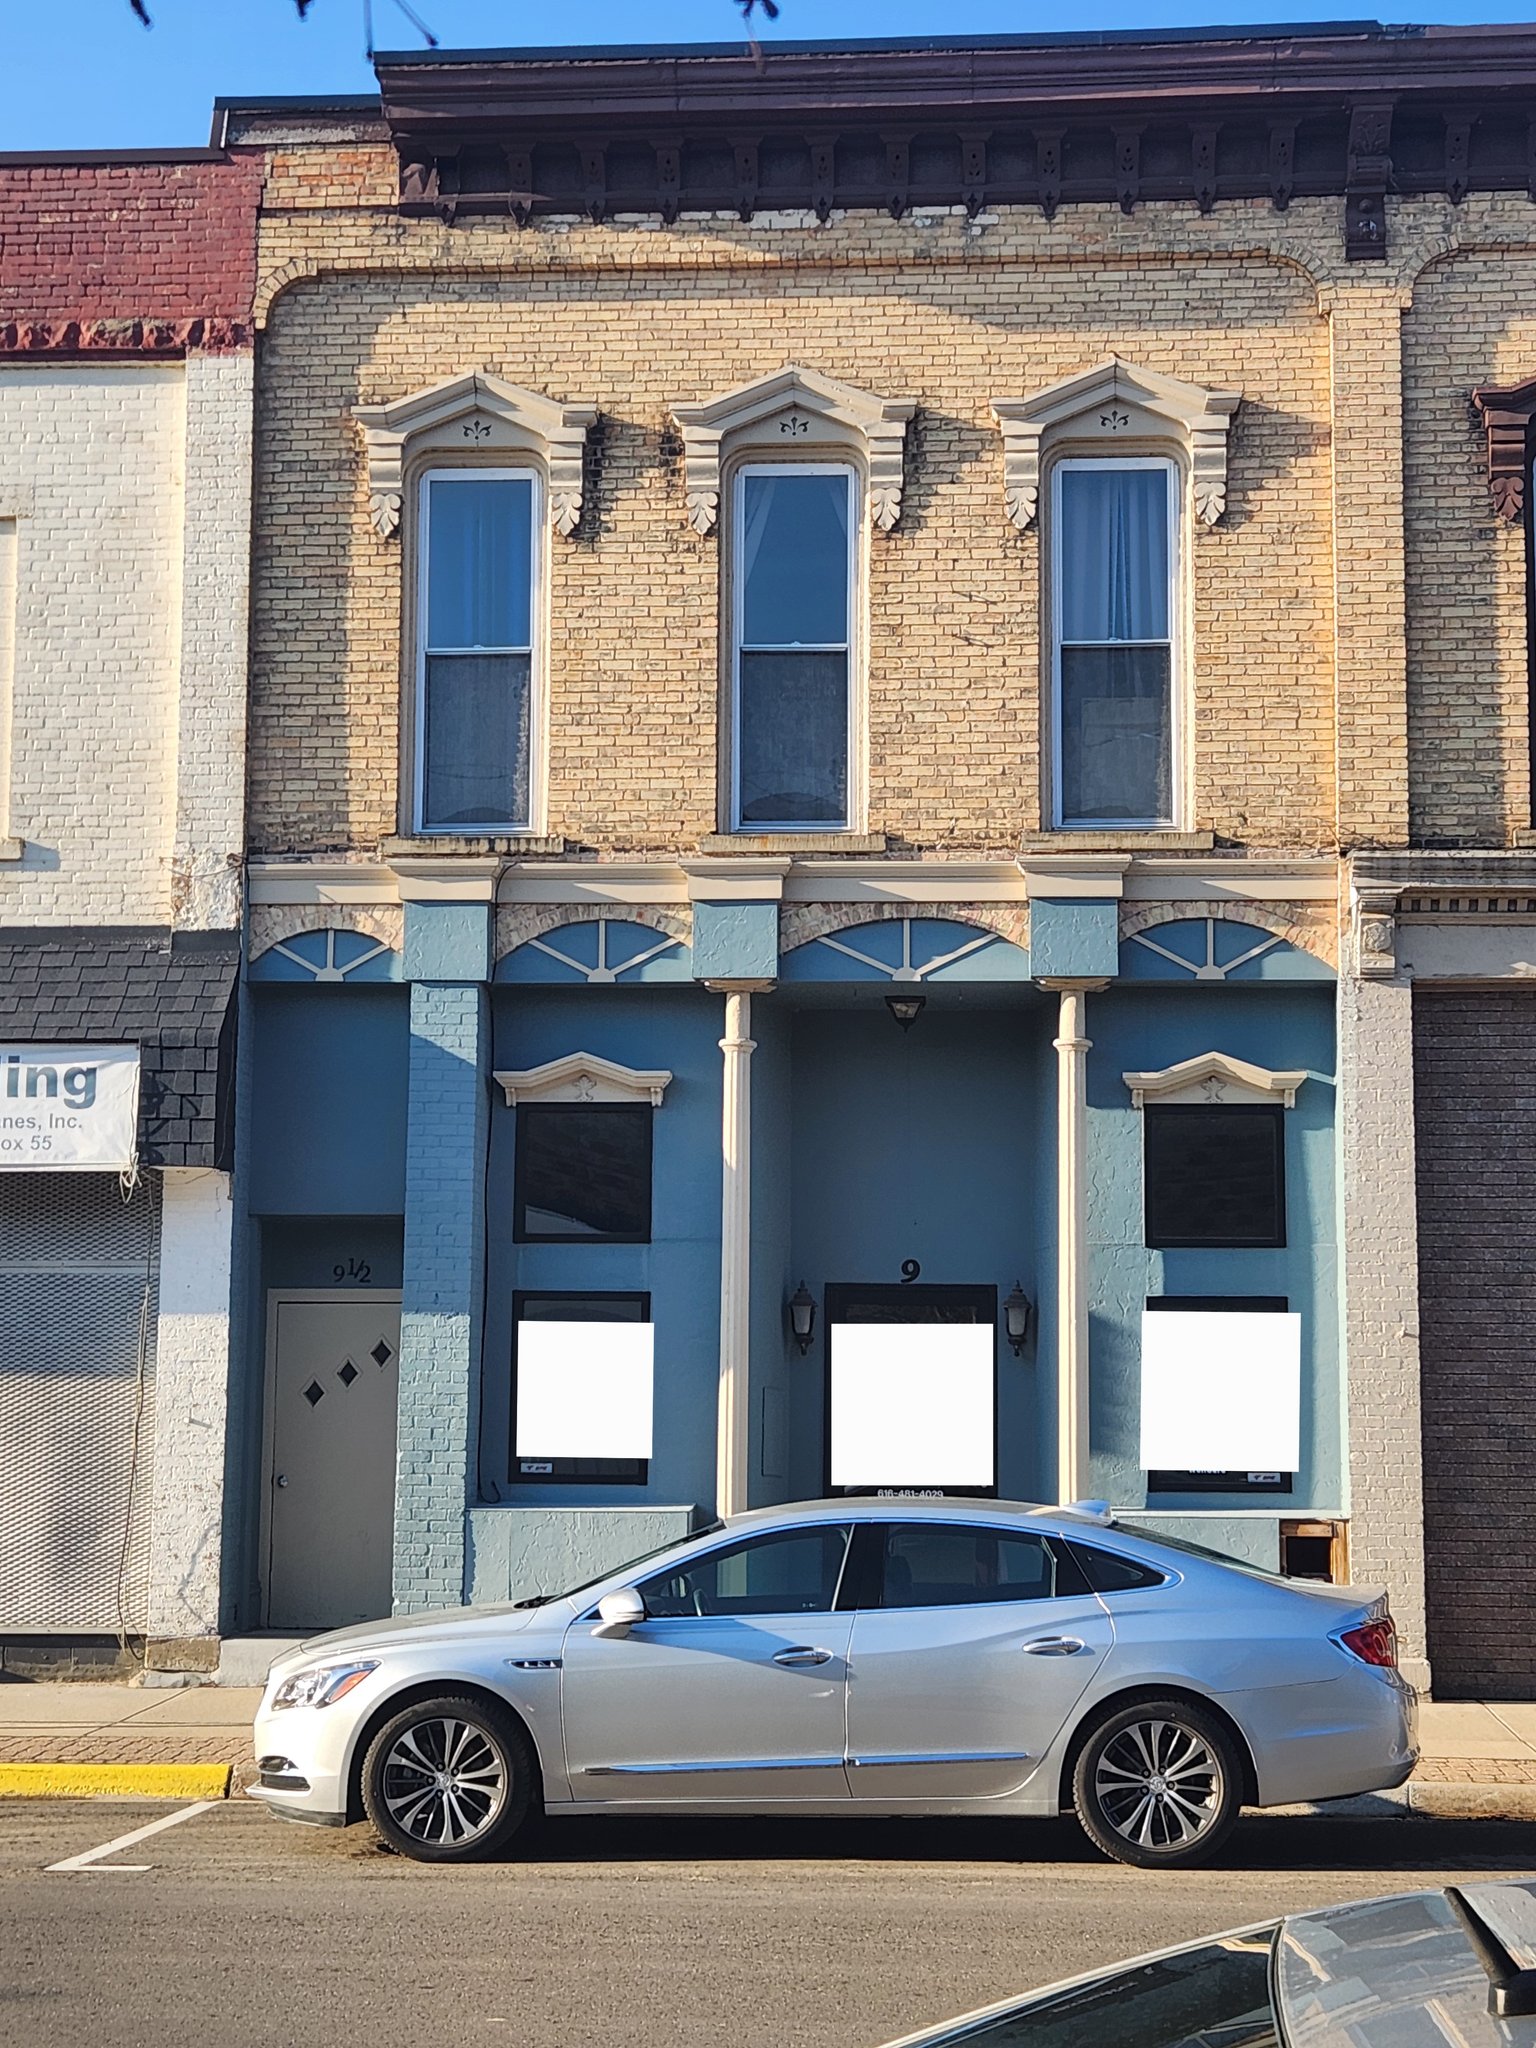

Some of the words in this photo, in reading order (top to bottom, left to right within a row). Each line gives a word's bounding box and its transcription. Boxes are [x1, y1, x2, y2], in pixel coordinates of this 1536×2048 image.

[0, 1055, 98, 1109] ing
[0, 1117, 41, 1131] nes,
[49, 1113, 82, 1129] Inc.
[0, 1139, 23, 1150] ox
[30, 1135, 52, 1150] 55
[901, 1259, 920, 1283] 9
[877, 1488, 944, 1498] 616-481-4029
